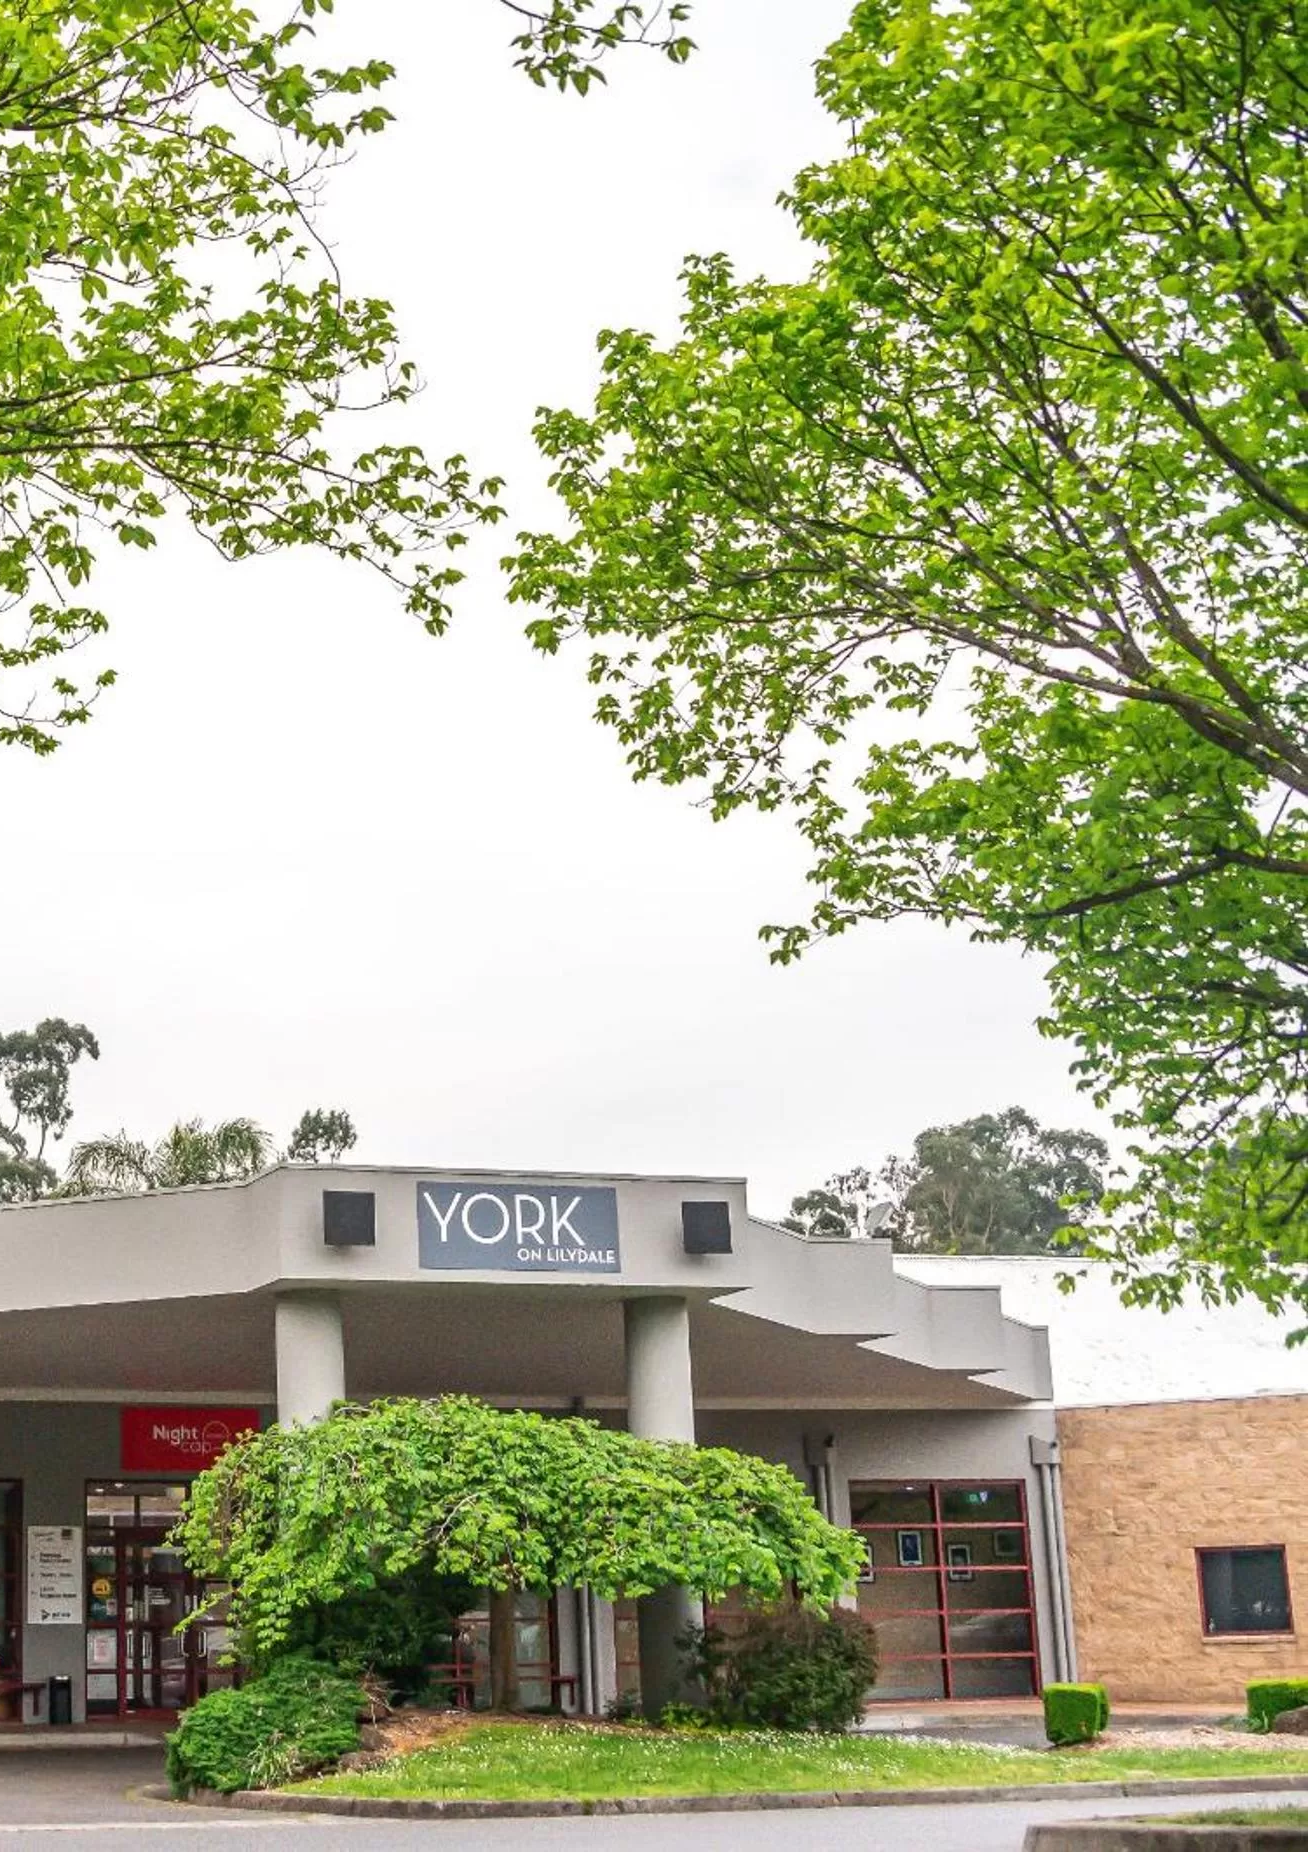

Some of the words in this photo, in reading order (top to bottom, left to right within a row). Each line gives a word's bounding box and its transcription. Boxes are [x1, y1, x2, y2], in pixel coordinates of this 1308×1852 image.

[423, 1192, 586, 1246] YORK
[517, 1248, 542, 1262] ON
[547, 1248, 616, 1264] LILYDALE
[152, 1424, 199, 1445] Night
[180, 1441, 212, 1456] cap
